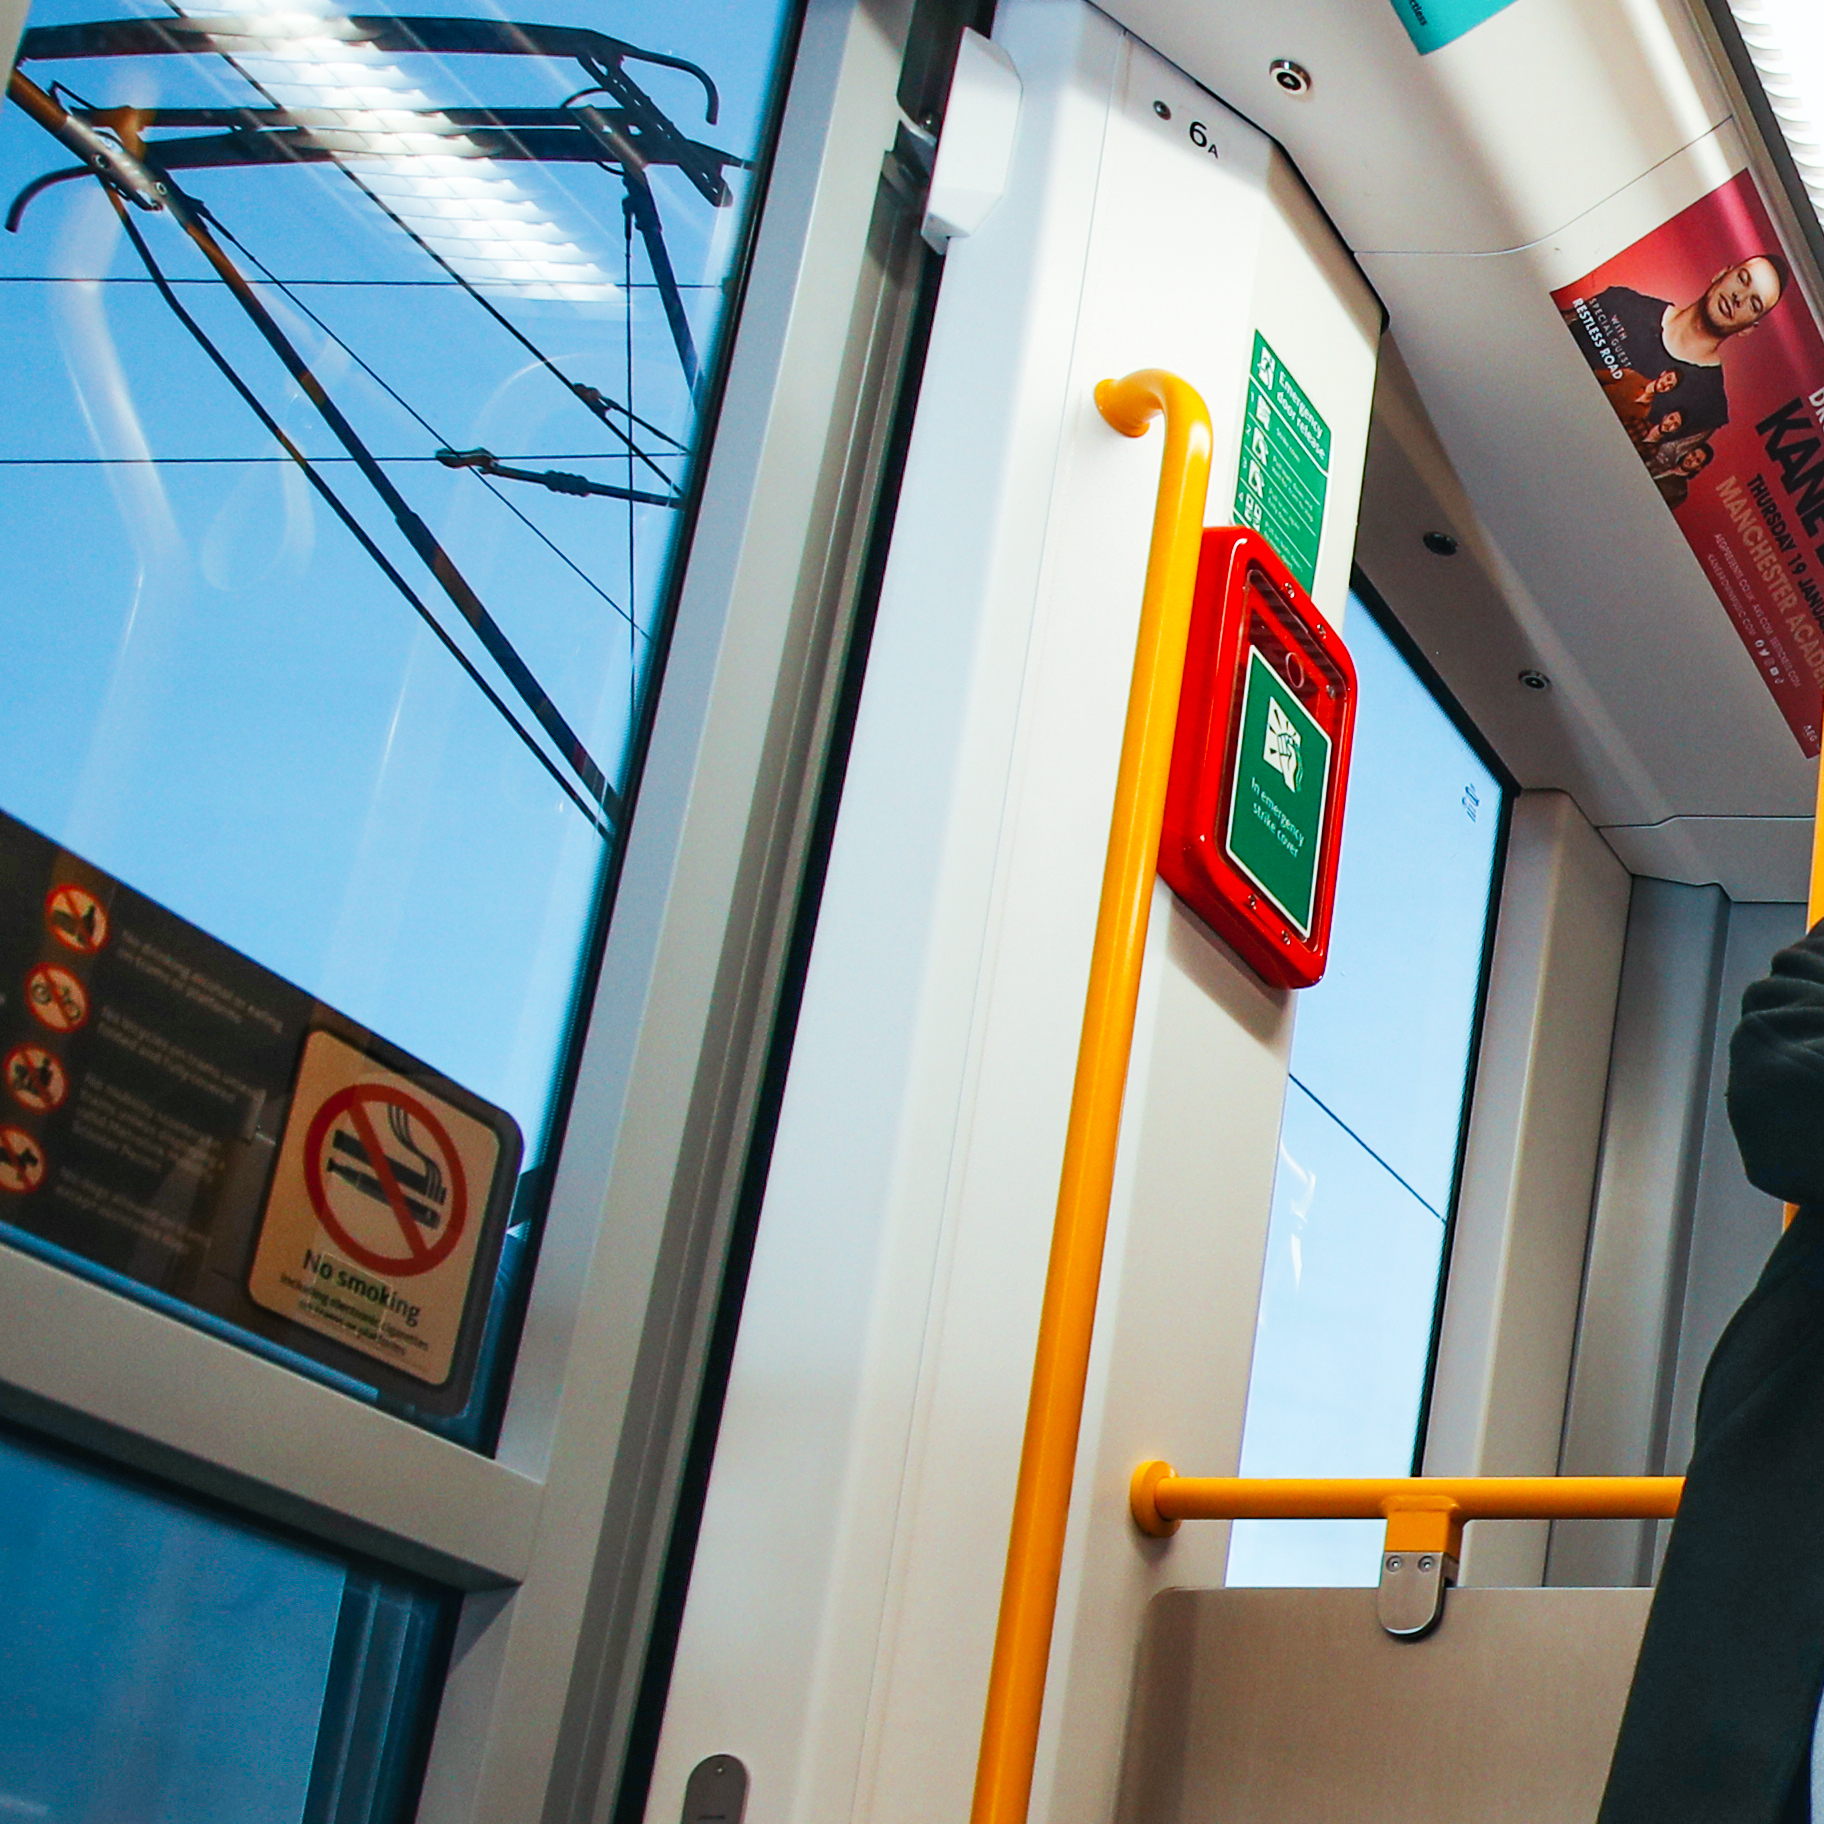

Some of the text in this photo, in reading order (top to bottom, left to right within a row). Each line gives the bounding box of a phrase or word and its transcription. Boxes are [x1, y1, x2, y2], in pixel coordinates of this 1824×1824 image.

[1571, 295, 1625, 382] RESTLESS ROAD
[1587, 296, 1632, 369] SPECIAL GUEST
[1608, 313, 1628, 342] WITH
[1276, 391, 1326, 461] door release
[1278, 370, 1324, 440] Emergency
[1713, 473, 1800, 615] MANCHESTER
[1744, 471, 1797, 557] THURSDAY
[1785, 552, 1808, 578] 19
[1251, 777, 1305, 847] In emergency
[1253, 803, 1299, 856] strike cover
[303, 1249, 421, 1327] No smoking
